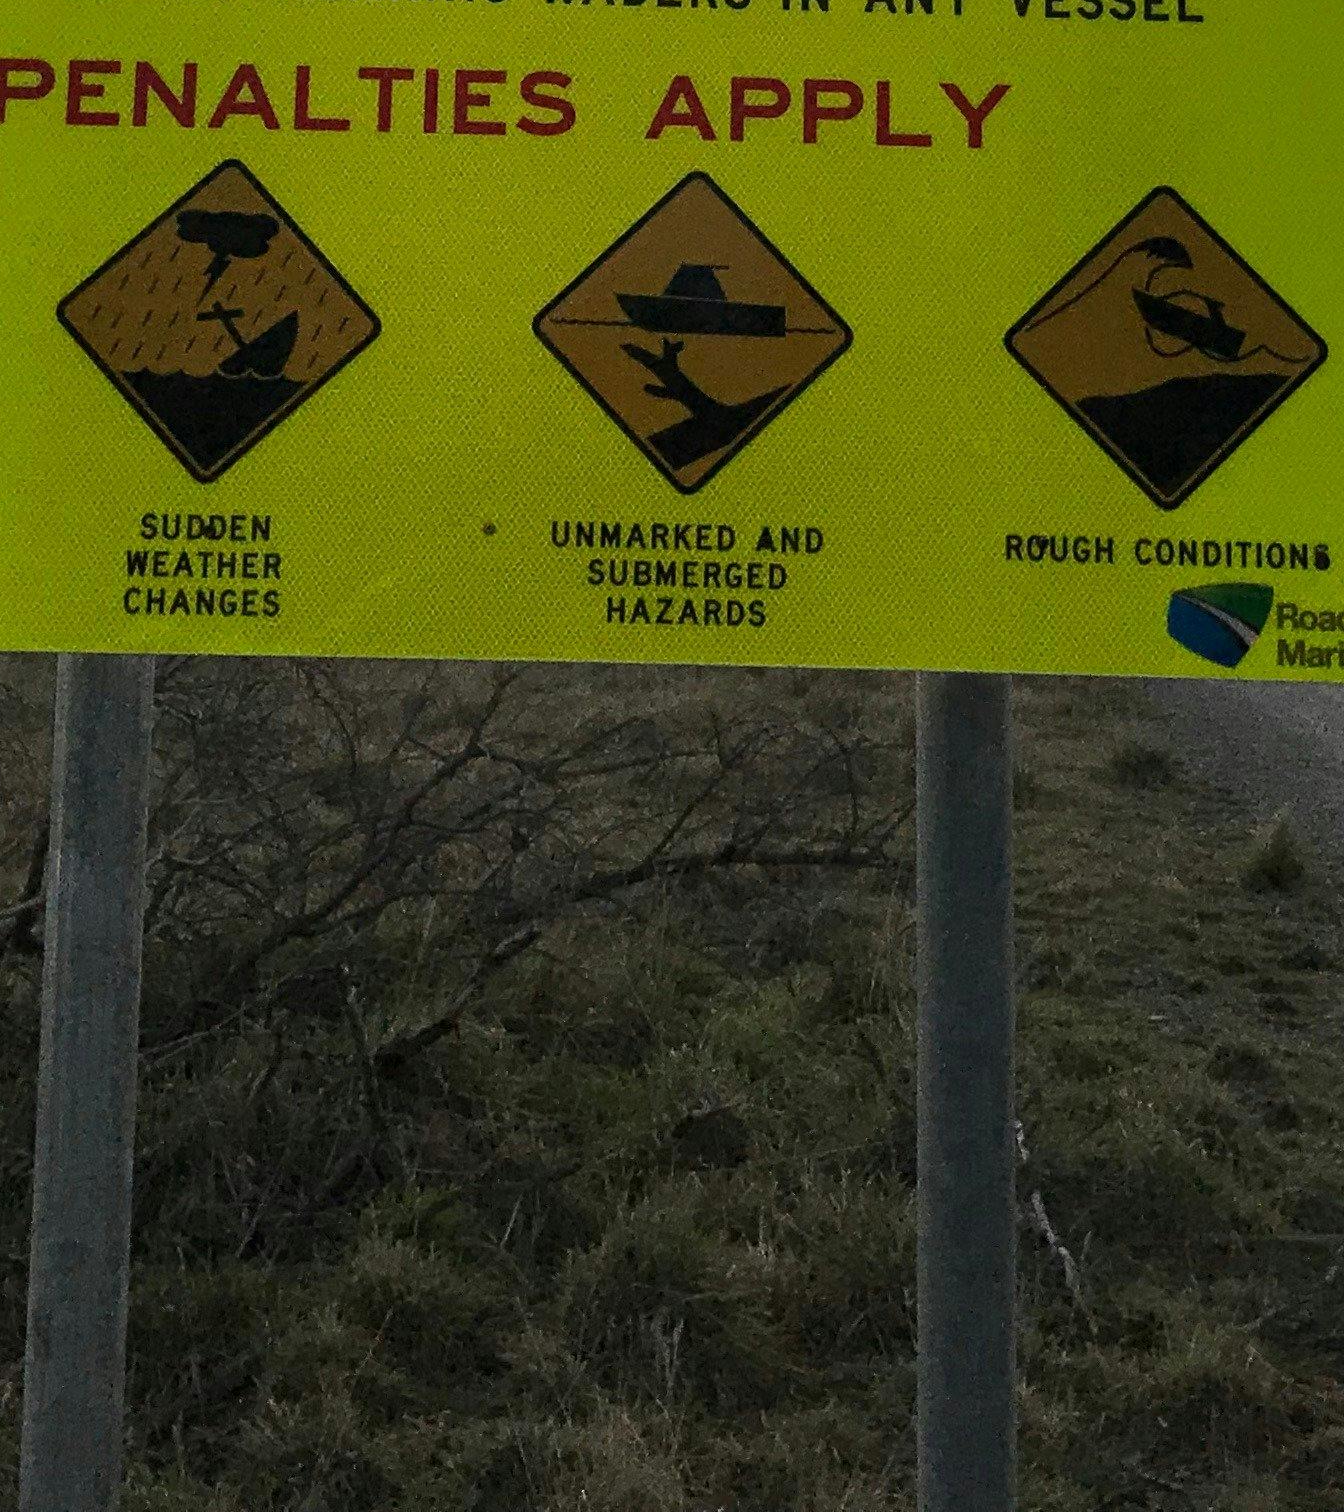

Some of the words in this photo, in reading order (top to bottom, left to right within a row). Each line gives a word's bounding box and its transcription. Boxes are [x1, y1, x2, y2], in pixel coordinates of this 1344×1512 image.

[645, 74, 1011, 149] APPLY
[140, 512, 272, 541] SUDDEN
[551, 521, 736, 550] UNMARKED
[756, 525, 824, 552] AND
[125, 550, 283, 579] WEATHER
[1004, 533, 1115, 562] ROUGH
[1133, 538, 1330, 569] CONDITIONS
[586, 558, 788, 588] SUBMERGED
[122, 586, 282, 615] CHANGES
[605, 597, 767, 625] HAZARDS
